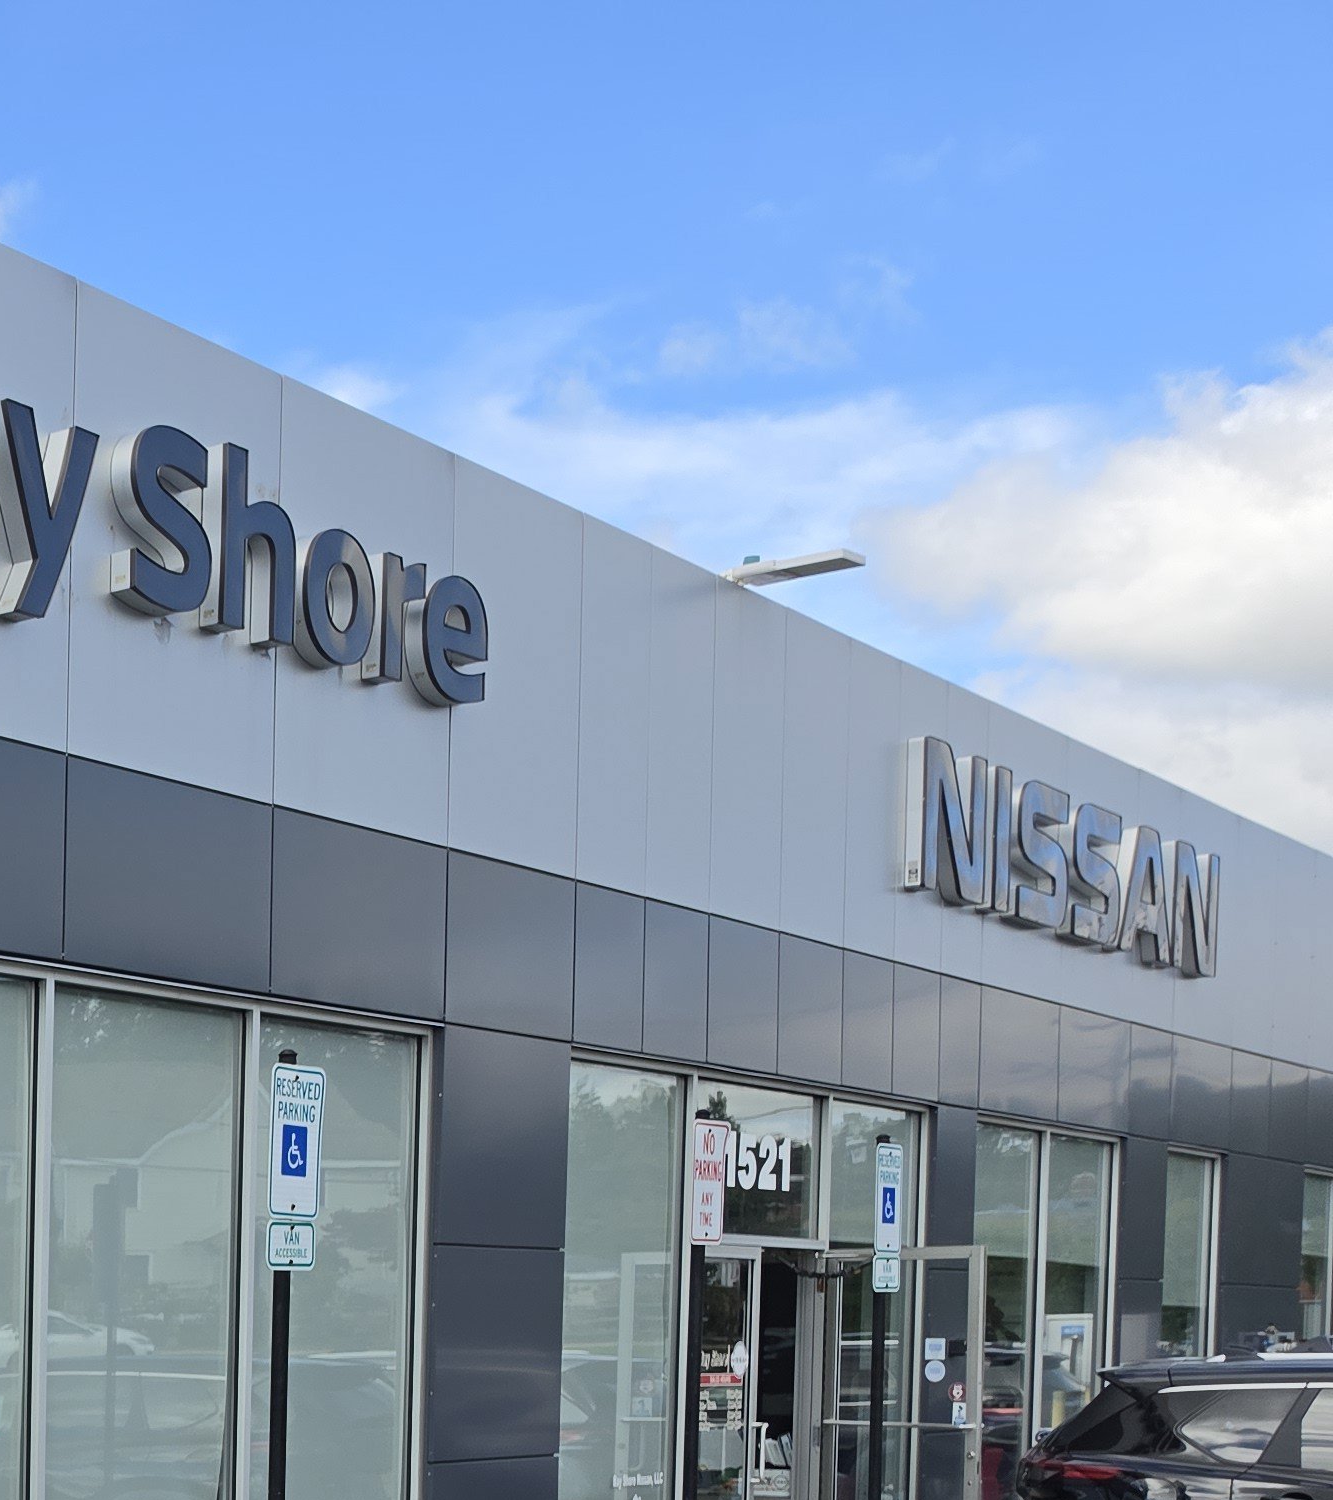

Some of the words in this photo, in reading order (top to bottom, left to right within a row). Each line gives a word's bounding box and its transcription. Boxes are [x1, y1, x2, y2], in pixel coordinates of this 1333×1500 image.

[111, 424, 489, 707] Shore
[904, 736, 1221, 979] NISSAN
[275, 1077, 321, 1101] RESERVED
[277, 1101, 316, 1123] PARKING
[702, 1132, 715, 1155] NO
[694, 1160, 722, 1181] PARKING
[725, 1130, 792, 1192] 1521
[701, 1191, 714, 1207] ANY
[699, 1211, 713, 1227] TIME
[283, 1231, 300, 1245] VAN
[274, 1247, 308, 1259] ACCESSIBLE
